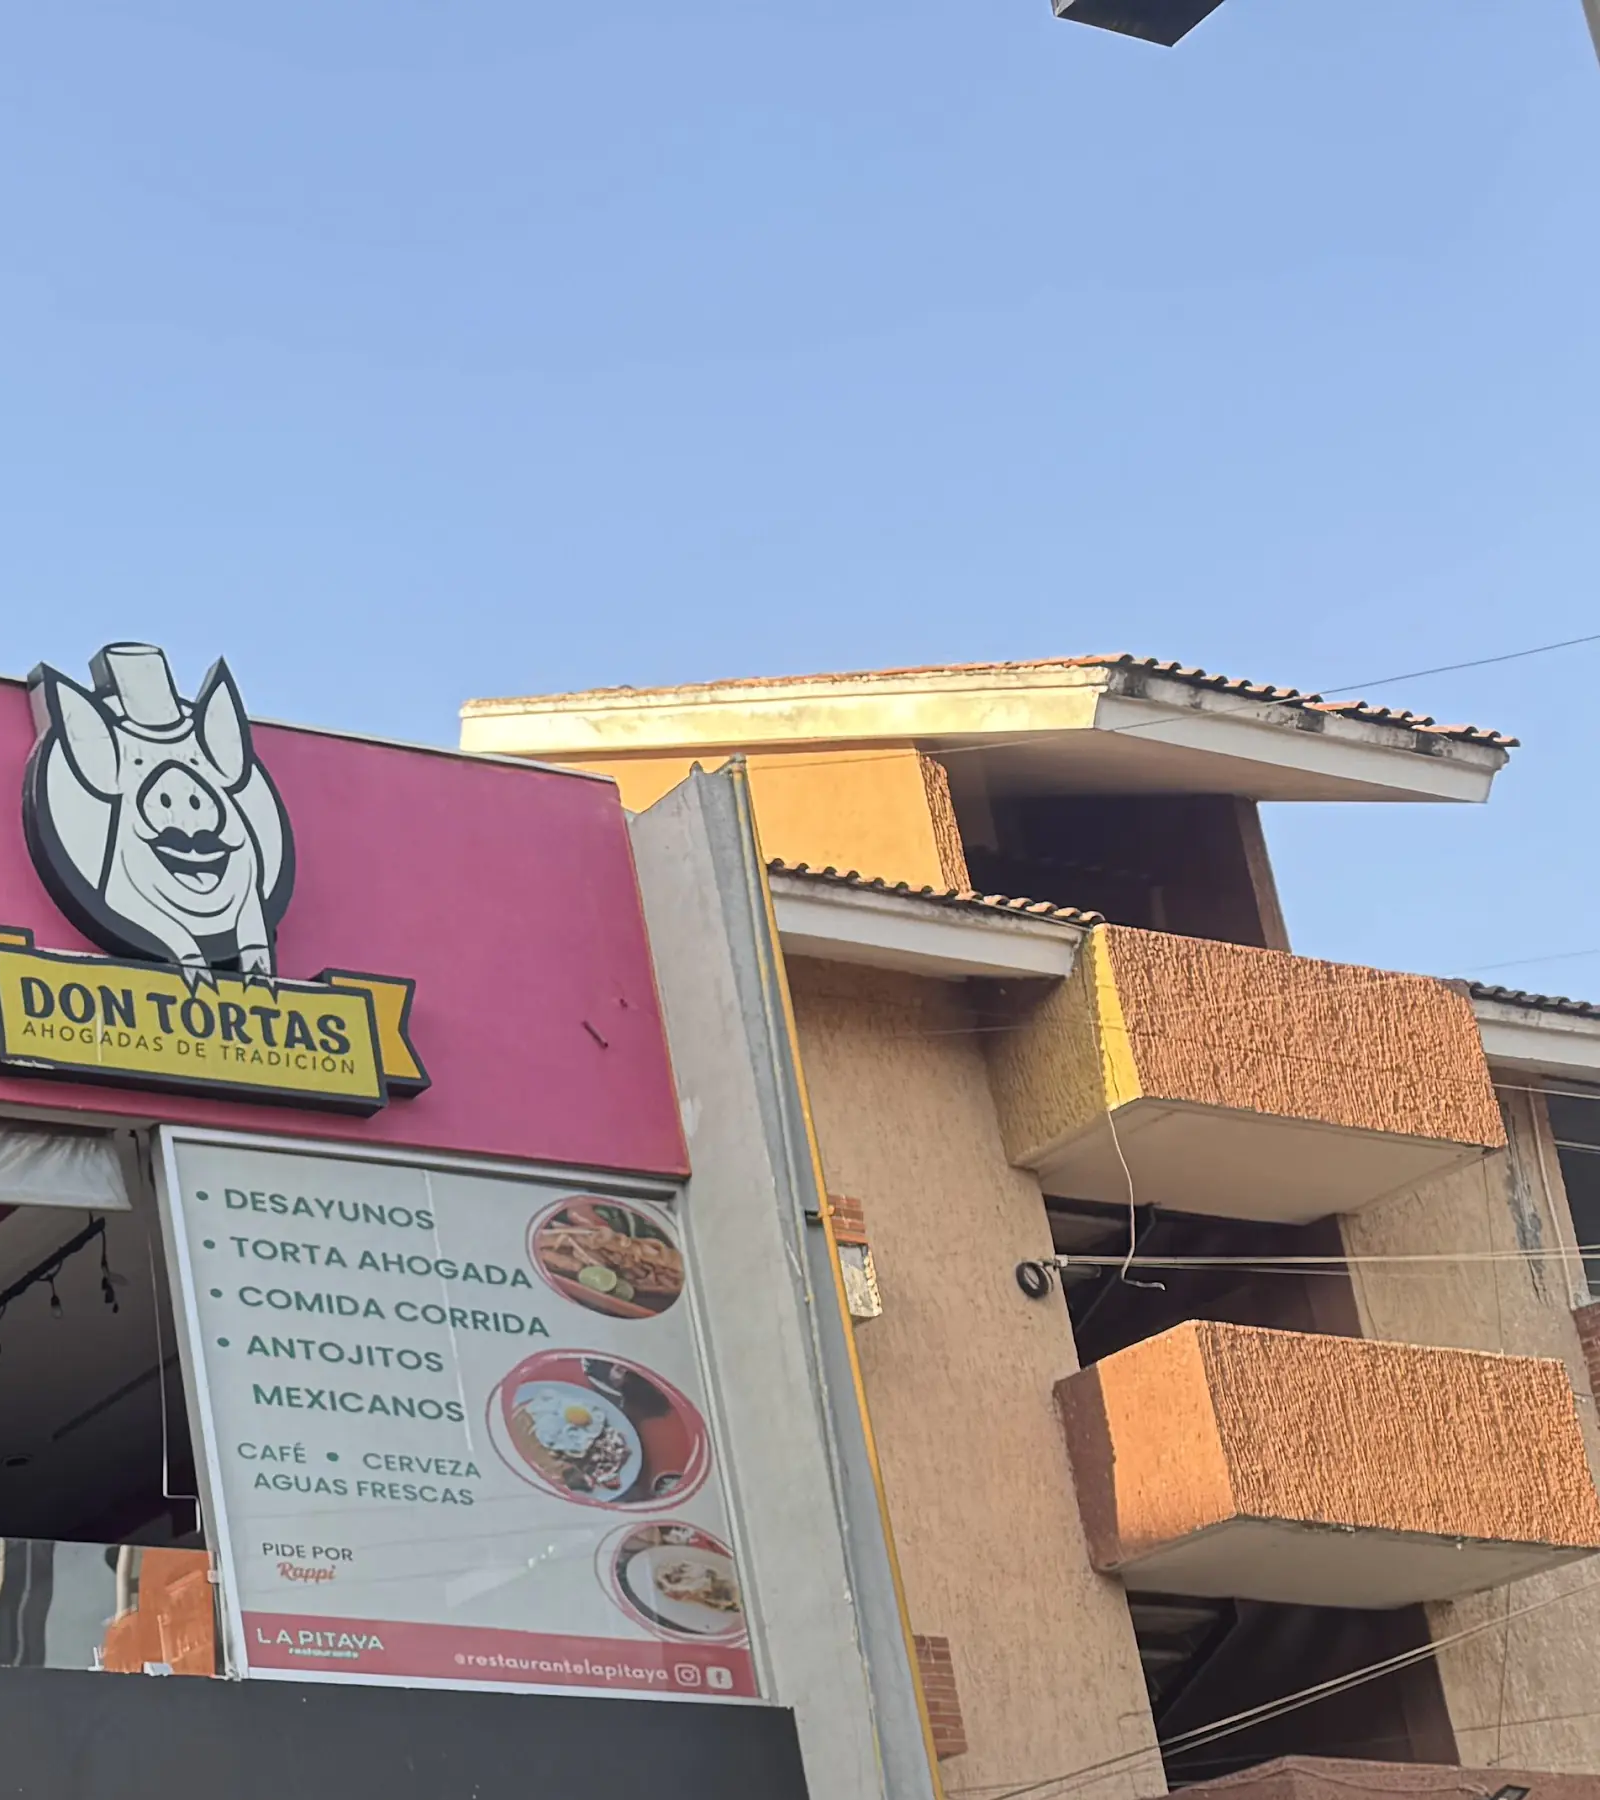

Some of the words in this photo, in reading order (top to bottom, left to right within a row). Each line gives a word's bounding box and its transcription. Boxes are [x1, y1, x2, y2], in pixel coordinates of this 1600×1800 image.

[20, 976, 137, 1028] DON
[147, 991, 352, 1056] TORTAS
[22, 1021, 164, 1053] AHOGADAS
[178, 1039, 207, 1059] DE
[219, 1044, 357, 1075] TRADICIÓN
[224, 1188, 436, 1231] DESAYUNOS
[230, 1236, 348, 1269] TORTA
[357, 1251, 534, 1290] AHOGADA
[237, 1285, 386, 1321] COMIDA
[394, 1301, 551, 1338] CORRIDA
[246, 1334, 445, 1373] ANTOJITOS
[252, 1383, 466, 1423] MEXICANOS
[237, 1441, 307, 1465] CAFÉ
[362, 1452, 482, 1479] CERVEZA
[254, 1472, 348, 1497] AGUAS
[356, 1481, 475, 1506] FRESCAS
[262, 1542, 307, 1560] PIDE
[312, 1544, 354, 1562] POR
[276, 1561, 337, 1584] Rappi
[256, 1627, 294, 1646] LA
[298, 1630, 385, 1652] PITAYA
[454, 1652, 669, 1683] @restaurantelapitaya
